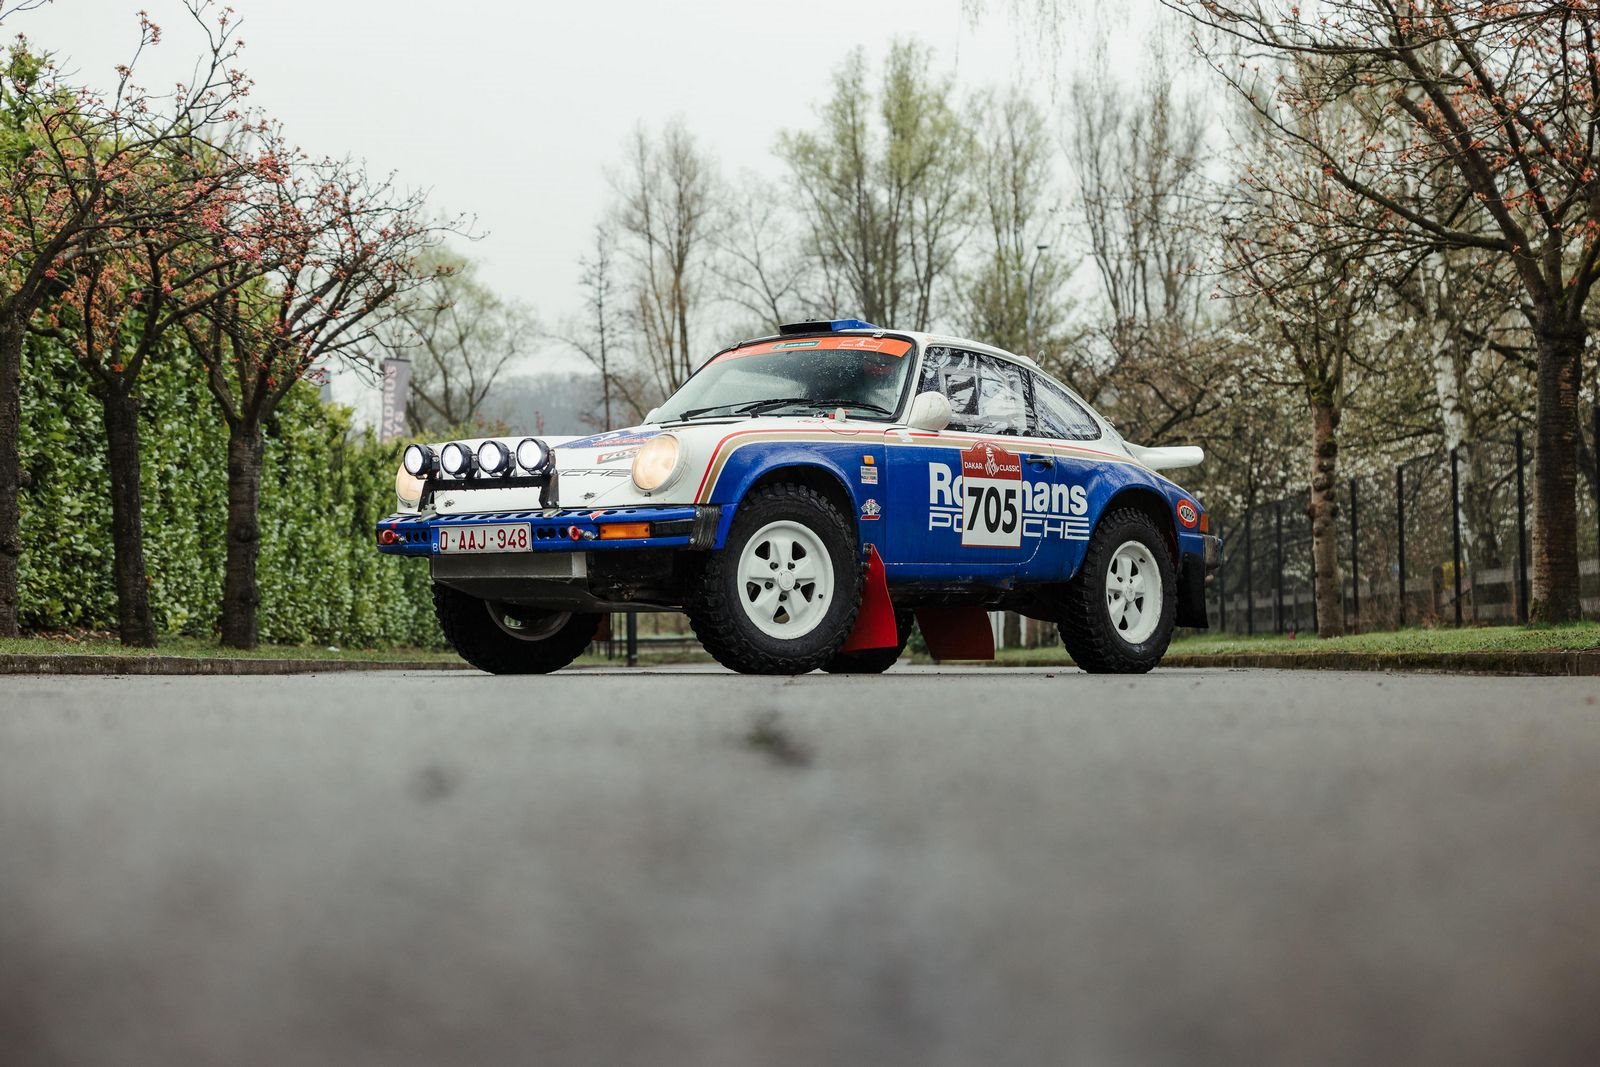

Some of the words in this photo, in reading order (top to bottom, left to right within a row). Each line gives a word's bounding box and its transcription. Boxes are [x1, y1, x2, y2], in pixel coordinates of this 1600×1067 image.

[928, 461, 1088, 516] Roans
[964, 461, 983, 470] DAKAR
[999, 464, 1020, 473] CLASSIC
[966, 486, 1018, 534] 705
